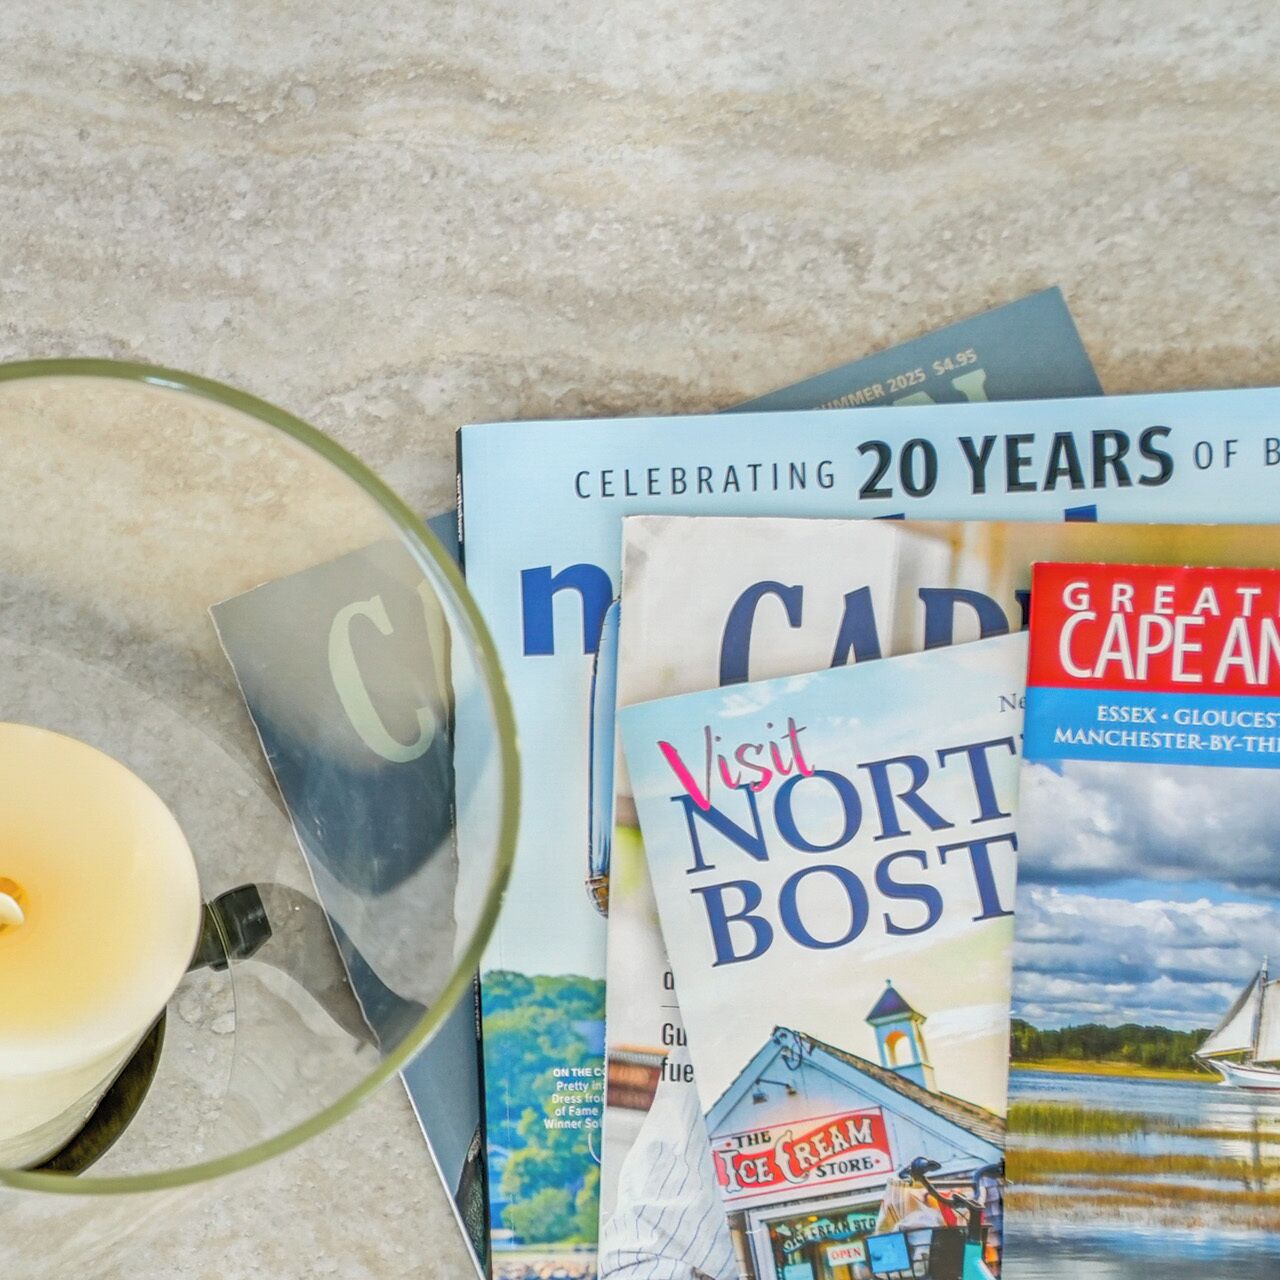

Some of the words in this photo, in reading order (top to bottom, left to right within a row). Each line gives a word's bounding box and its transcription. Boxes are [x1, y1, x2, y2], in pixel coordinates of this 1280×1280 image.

[887, 368, 927, 393] 2025
[932, 348, 977, 375] $4.95
[575, 458, 836, 499] CELEBRATING
[858, 437, 938, 501] 20
[959, 426, 1175, 495] YEARS
[1193, 439, 1240, 471] OF
[1062, 581, 1280, 617] GREAT
[1059, 611, 1205, 683] CAPE
[1213, 617, 1280, 685] AN
[1097, 704, 1157, 724] ESSEX
[656, 716, 815, 811] Visit
[670, 736, 1018, 875] NORT
[690, 831, 1019, 968] BOST
[553, 1068, 569, 1077] ON
[571, 1068, 592, 1077] THE
[556, 1081, 589, 1092] Pretty
[552, 1094, 582, 1103] Dress
[555, 1106, 566, 1116] of
[569, 1106, 599, 1116] Fame
[544, 1119, 582, 1129] Winner
[732, 1130, 772, 1149] THE
[718, 1150, 774, 1193] ICE
[774, 1117, 873, 1184] CREAM
[816, 1156, 874, 1178] STORE
[853, 1218, 877, 1230] STO
[831, 1248, 861, 1259] OPEN
